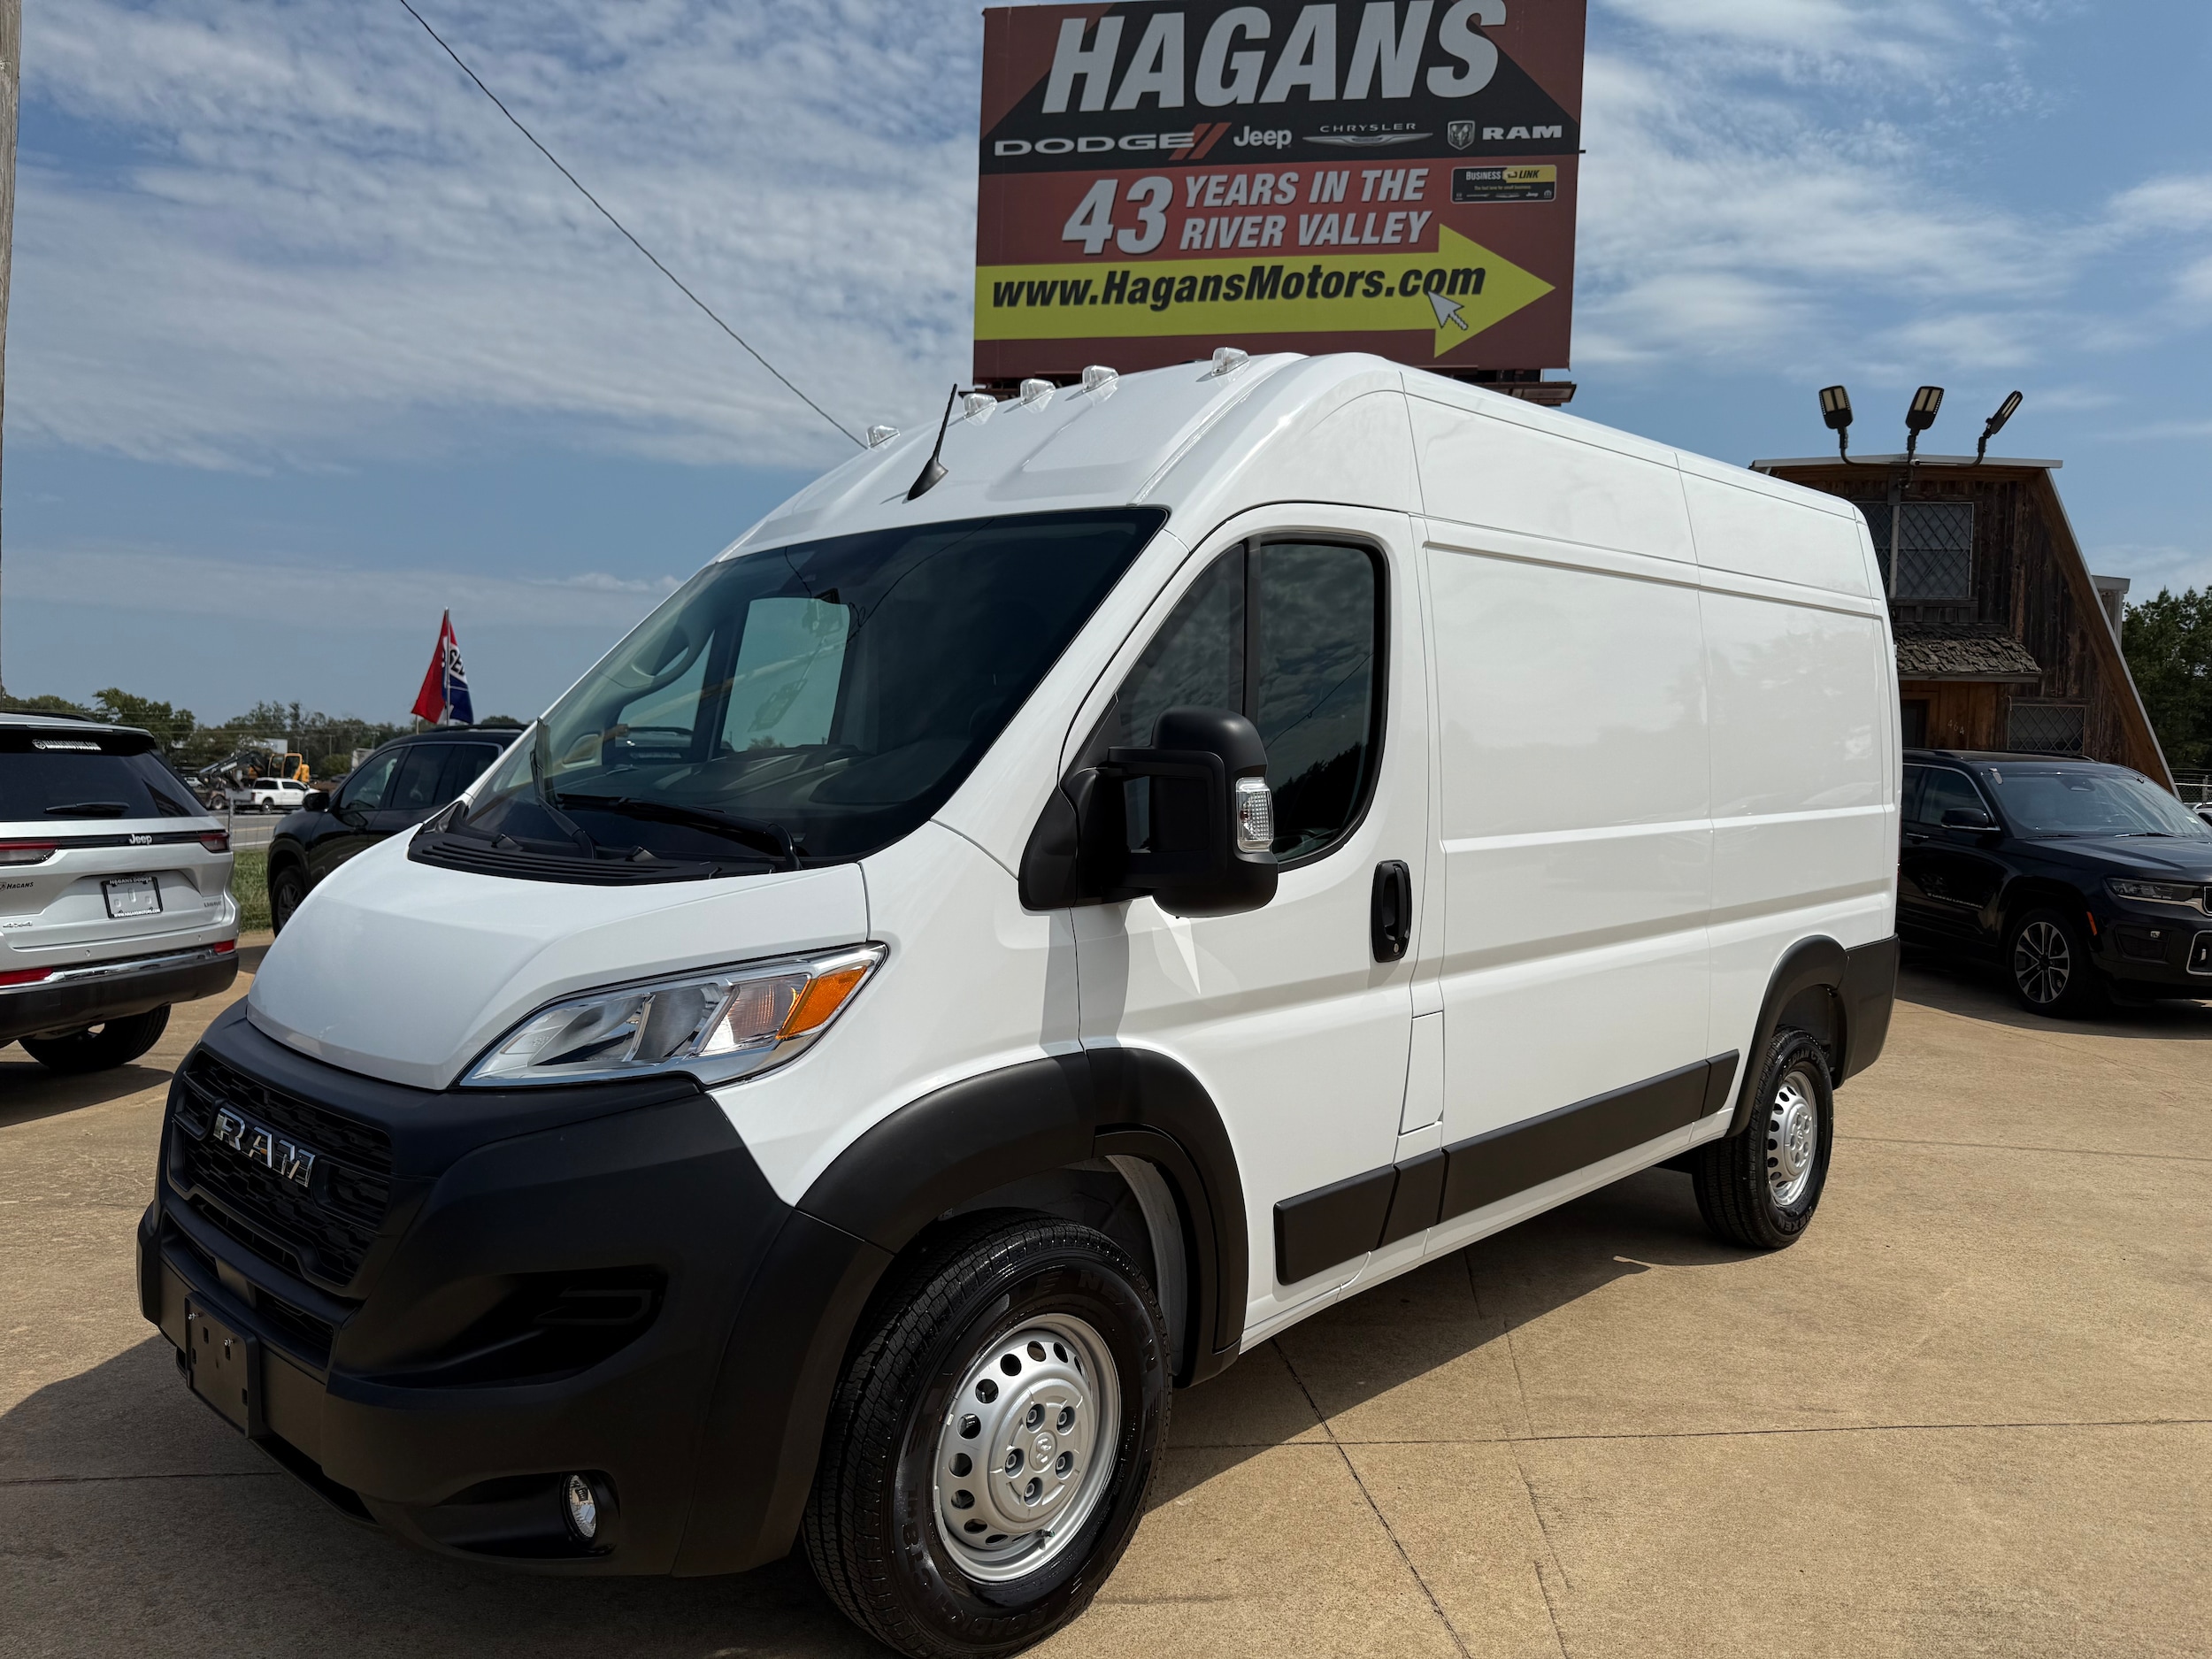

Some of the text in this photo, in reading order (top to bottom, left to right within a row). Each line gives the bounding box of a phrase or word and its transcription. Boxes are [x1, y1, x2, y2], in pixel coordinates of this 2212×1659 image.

[1041, 0, 1506, 114] HAGANS
[1233, 126, 1293, 150] Jeep
[1319, 123, 1417, 134] CHRYSLER
[1482, 125, 1563, 141] RAM
[995, 132, 1194, 157] DODGE
[1465, 169, 1540, 181] BUSINESS LINK
[1185, 168, 1430, 209] YEARS IN THE
[1062, 175, 1174, 256] 43
[1179, 211, 1433, 251] RIVER VALLEY
[992, 265, 1486, 312] www.HagansMotors.com
[128, 833, 153, 845] Jeep
[6, 881, 35, 890] HAGANS
[212, 1106, 318, 1188] RAM
